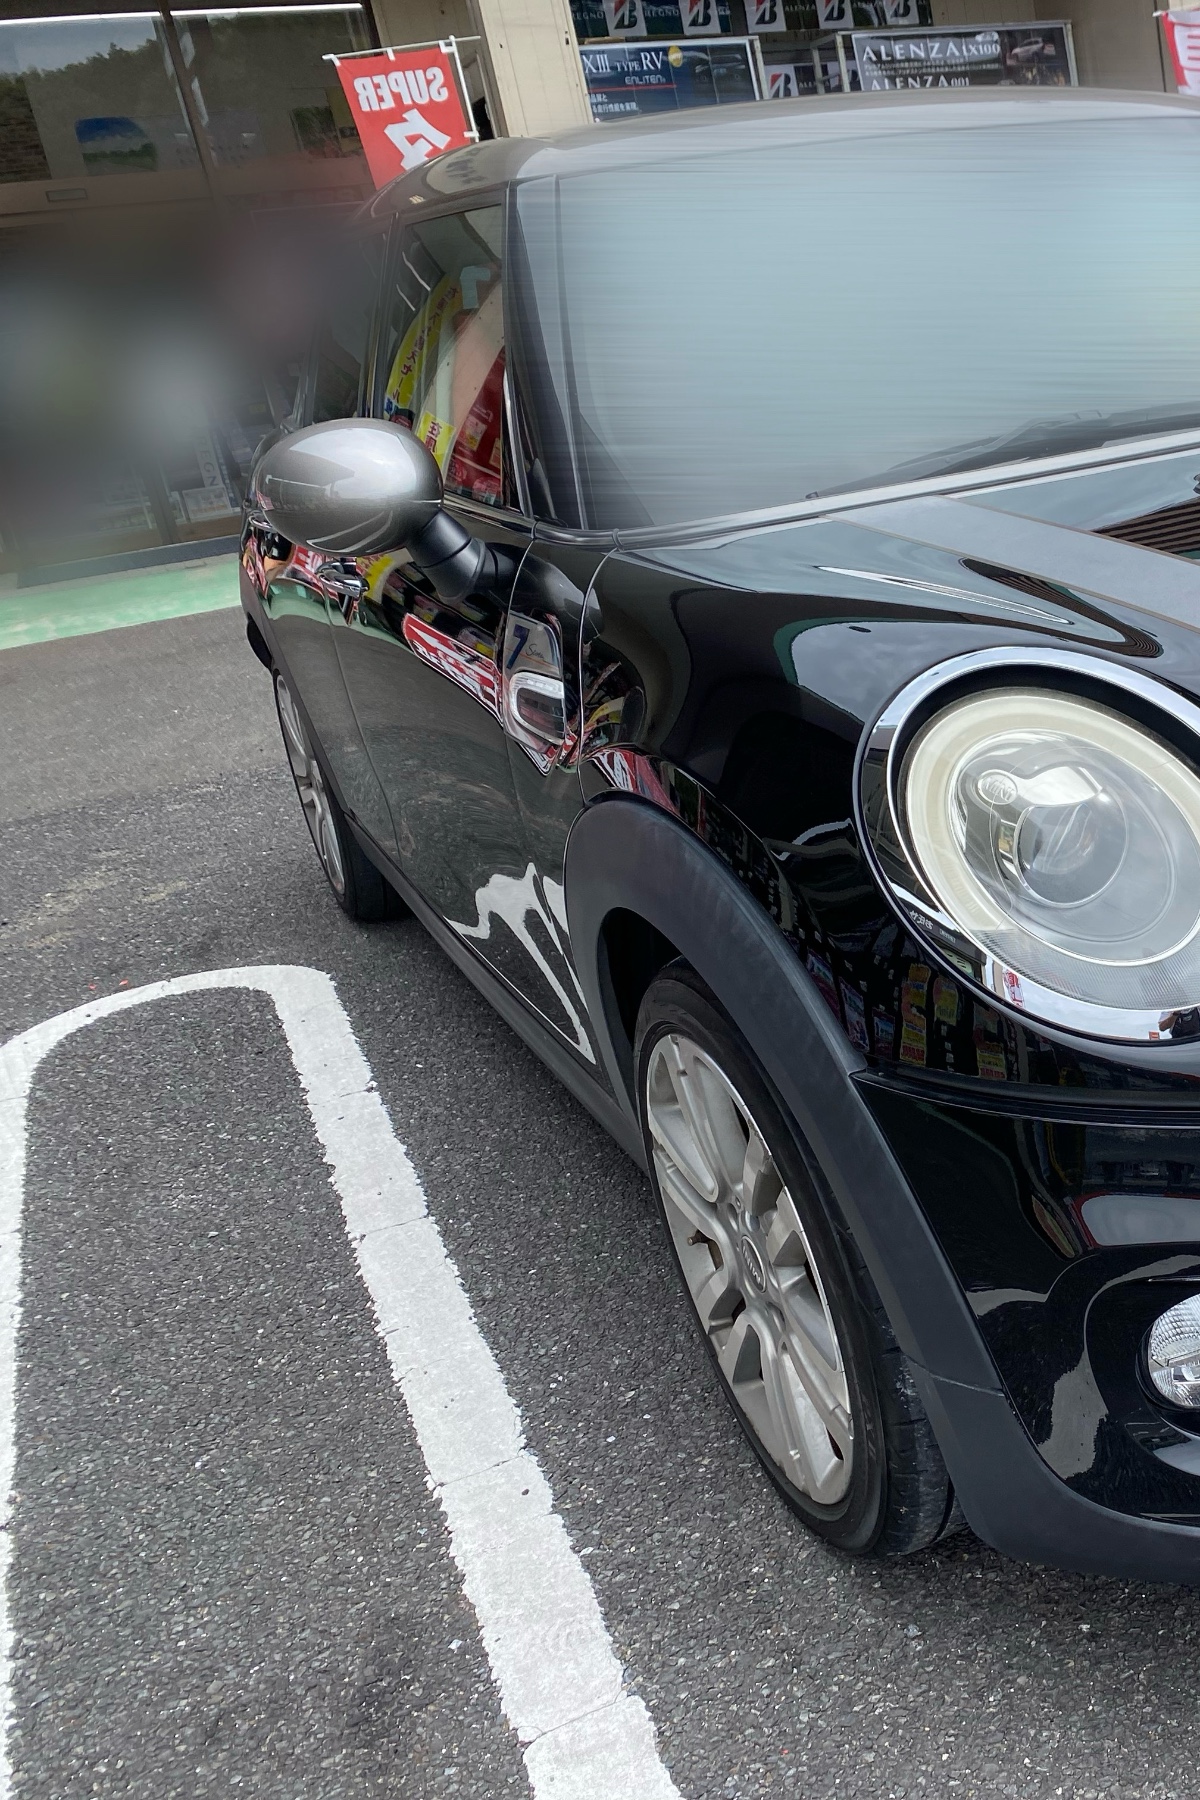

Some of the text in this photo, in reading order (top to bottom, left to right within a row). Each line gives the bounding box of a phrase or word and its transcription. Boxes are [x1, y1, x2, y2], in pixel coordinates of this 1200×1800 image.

[614, 60, 641, 72] TYPE
[640, 51, 663, 72] RV
[863, 42, 959, 62] ALENZA
